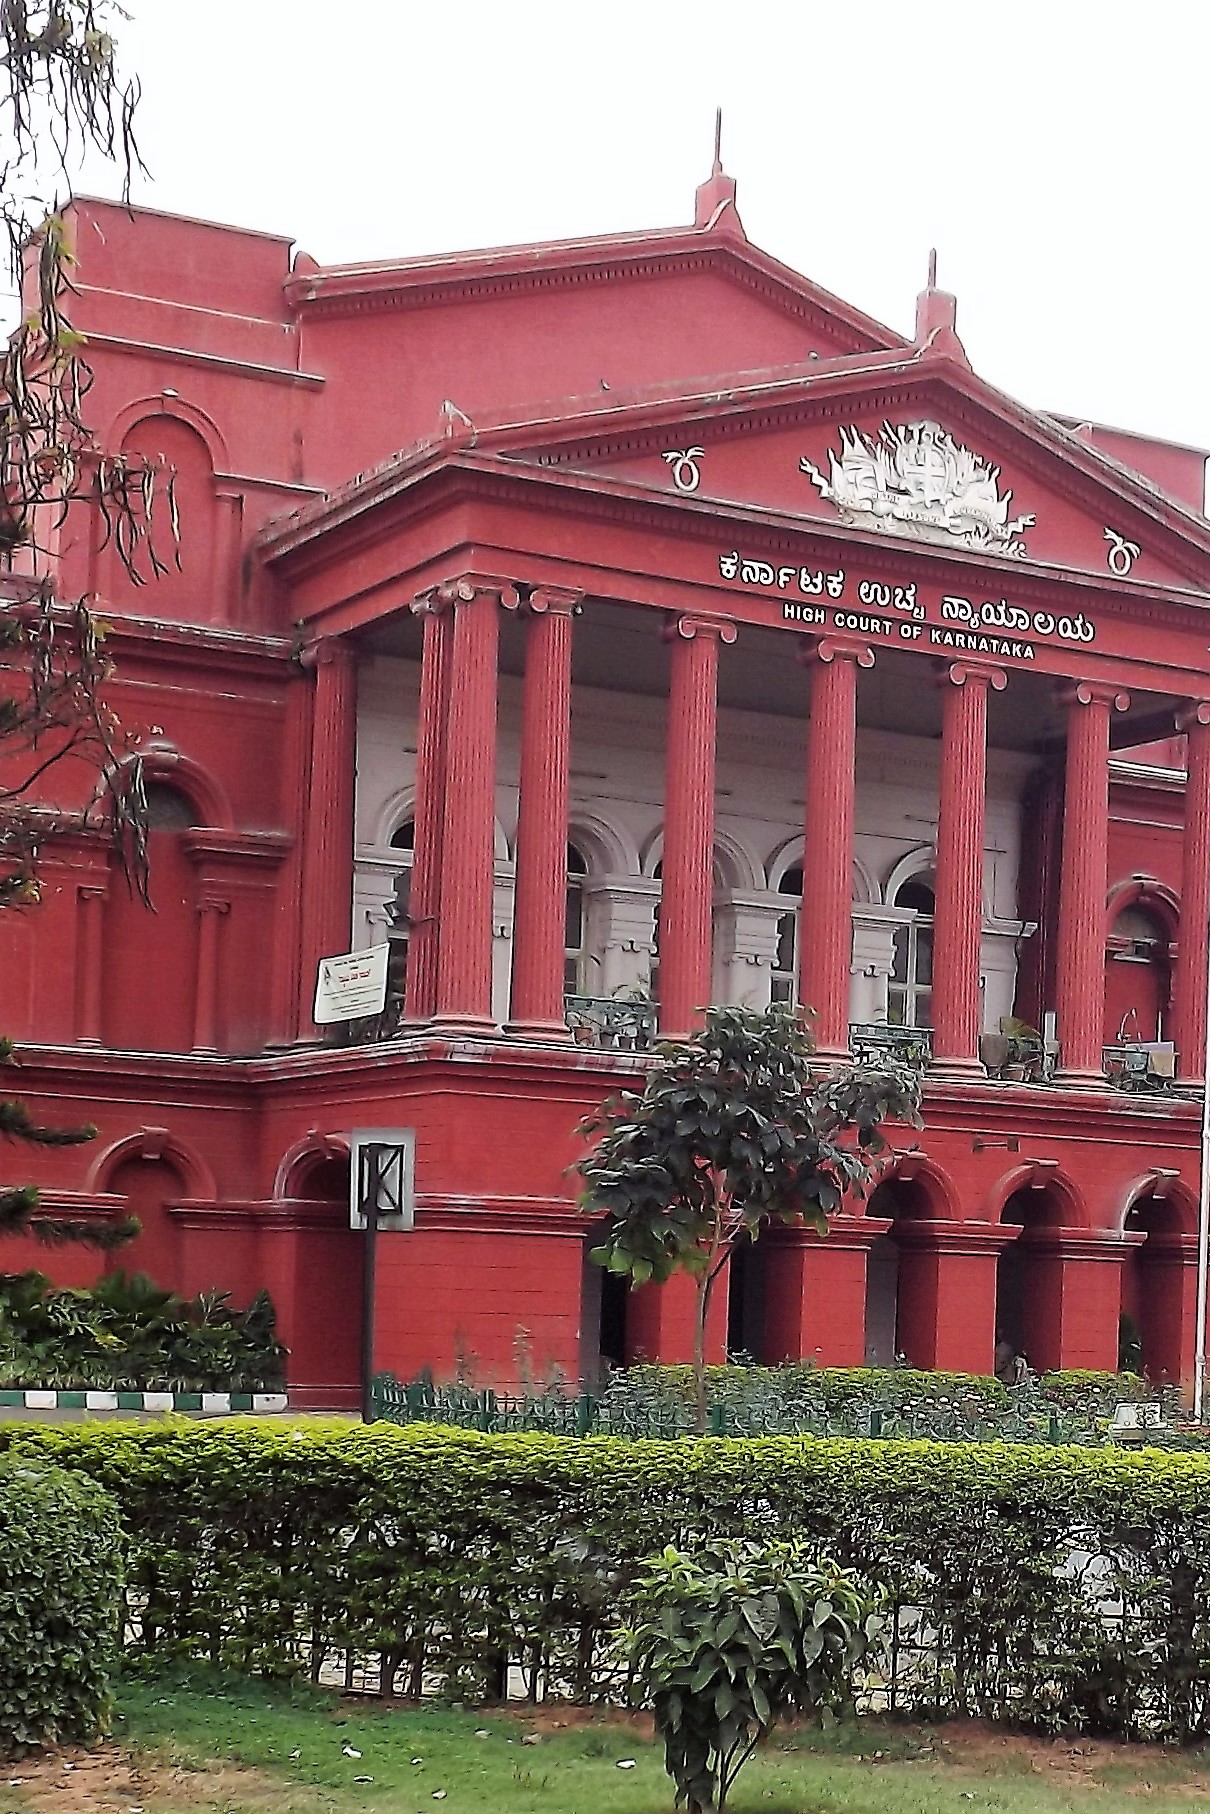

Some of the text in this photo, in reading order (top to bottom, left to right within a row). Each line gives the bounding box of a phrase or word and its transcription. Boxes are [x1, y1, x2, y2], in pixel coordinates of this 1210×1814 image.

[719, 551, 1095, 642] ಕರ್ನಾಟಕ ಉಚ್ಚ ನ್ಯಾಯಾಲಯ
[784, 603, 1035, 660] HIGH COURT OF KARNATAKA
